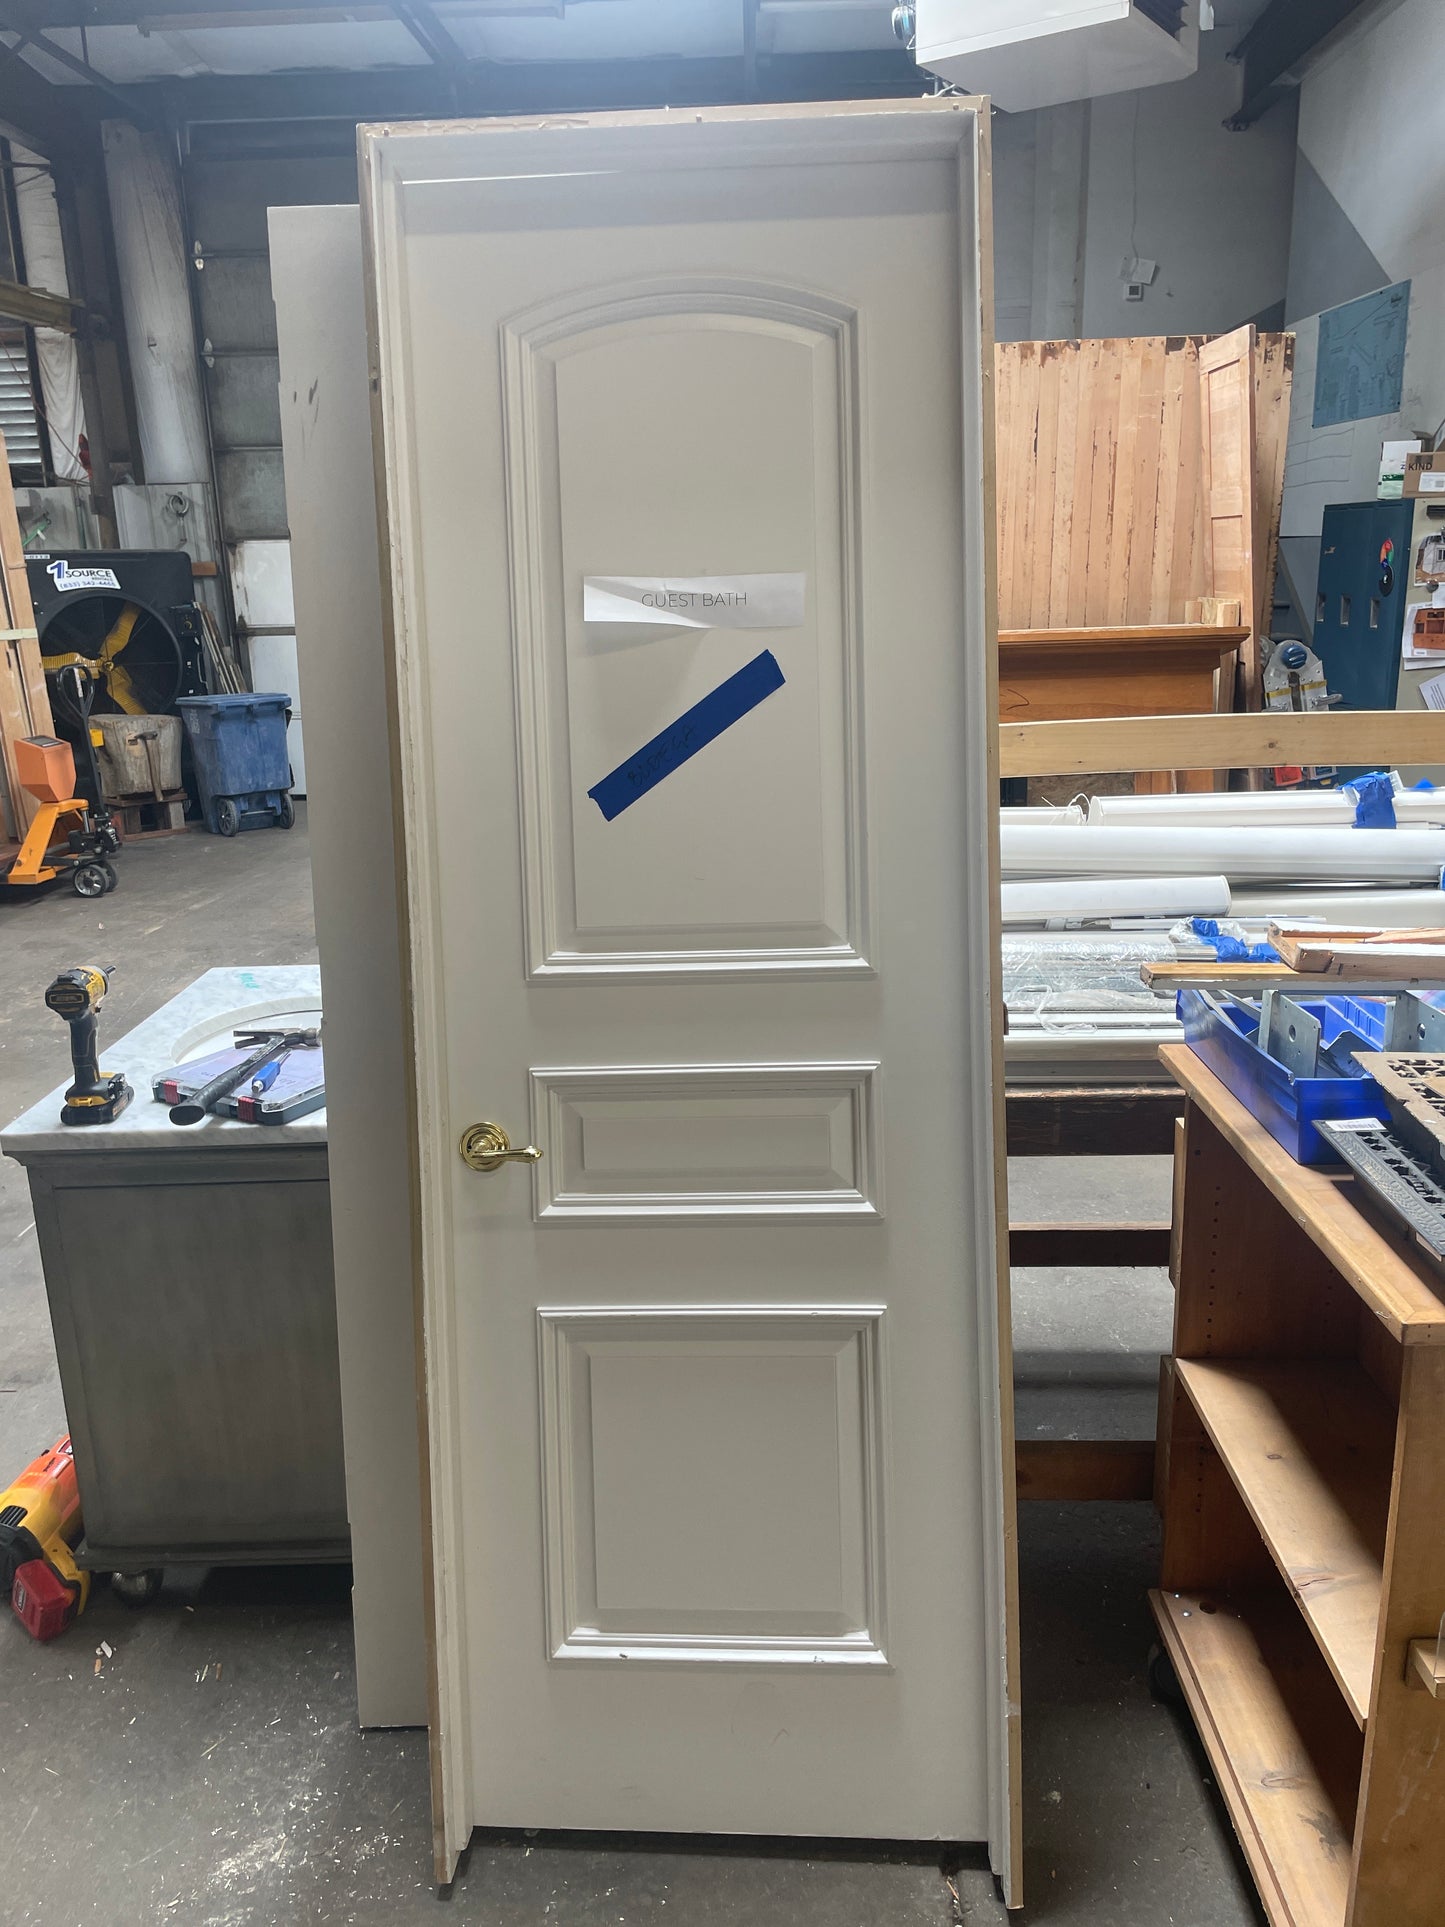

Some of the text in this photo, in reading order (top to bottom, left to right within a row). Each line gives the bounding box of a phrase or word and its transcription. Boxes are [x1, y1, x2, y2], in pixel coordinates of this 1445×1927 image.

[1408, 462, 1433, 471] KIND
[641, 592, 747, 608] GUEST BATH
